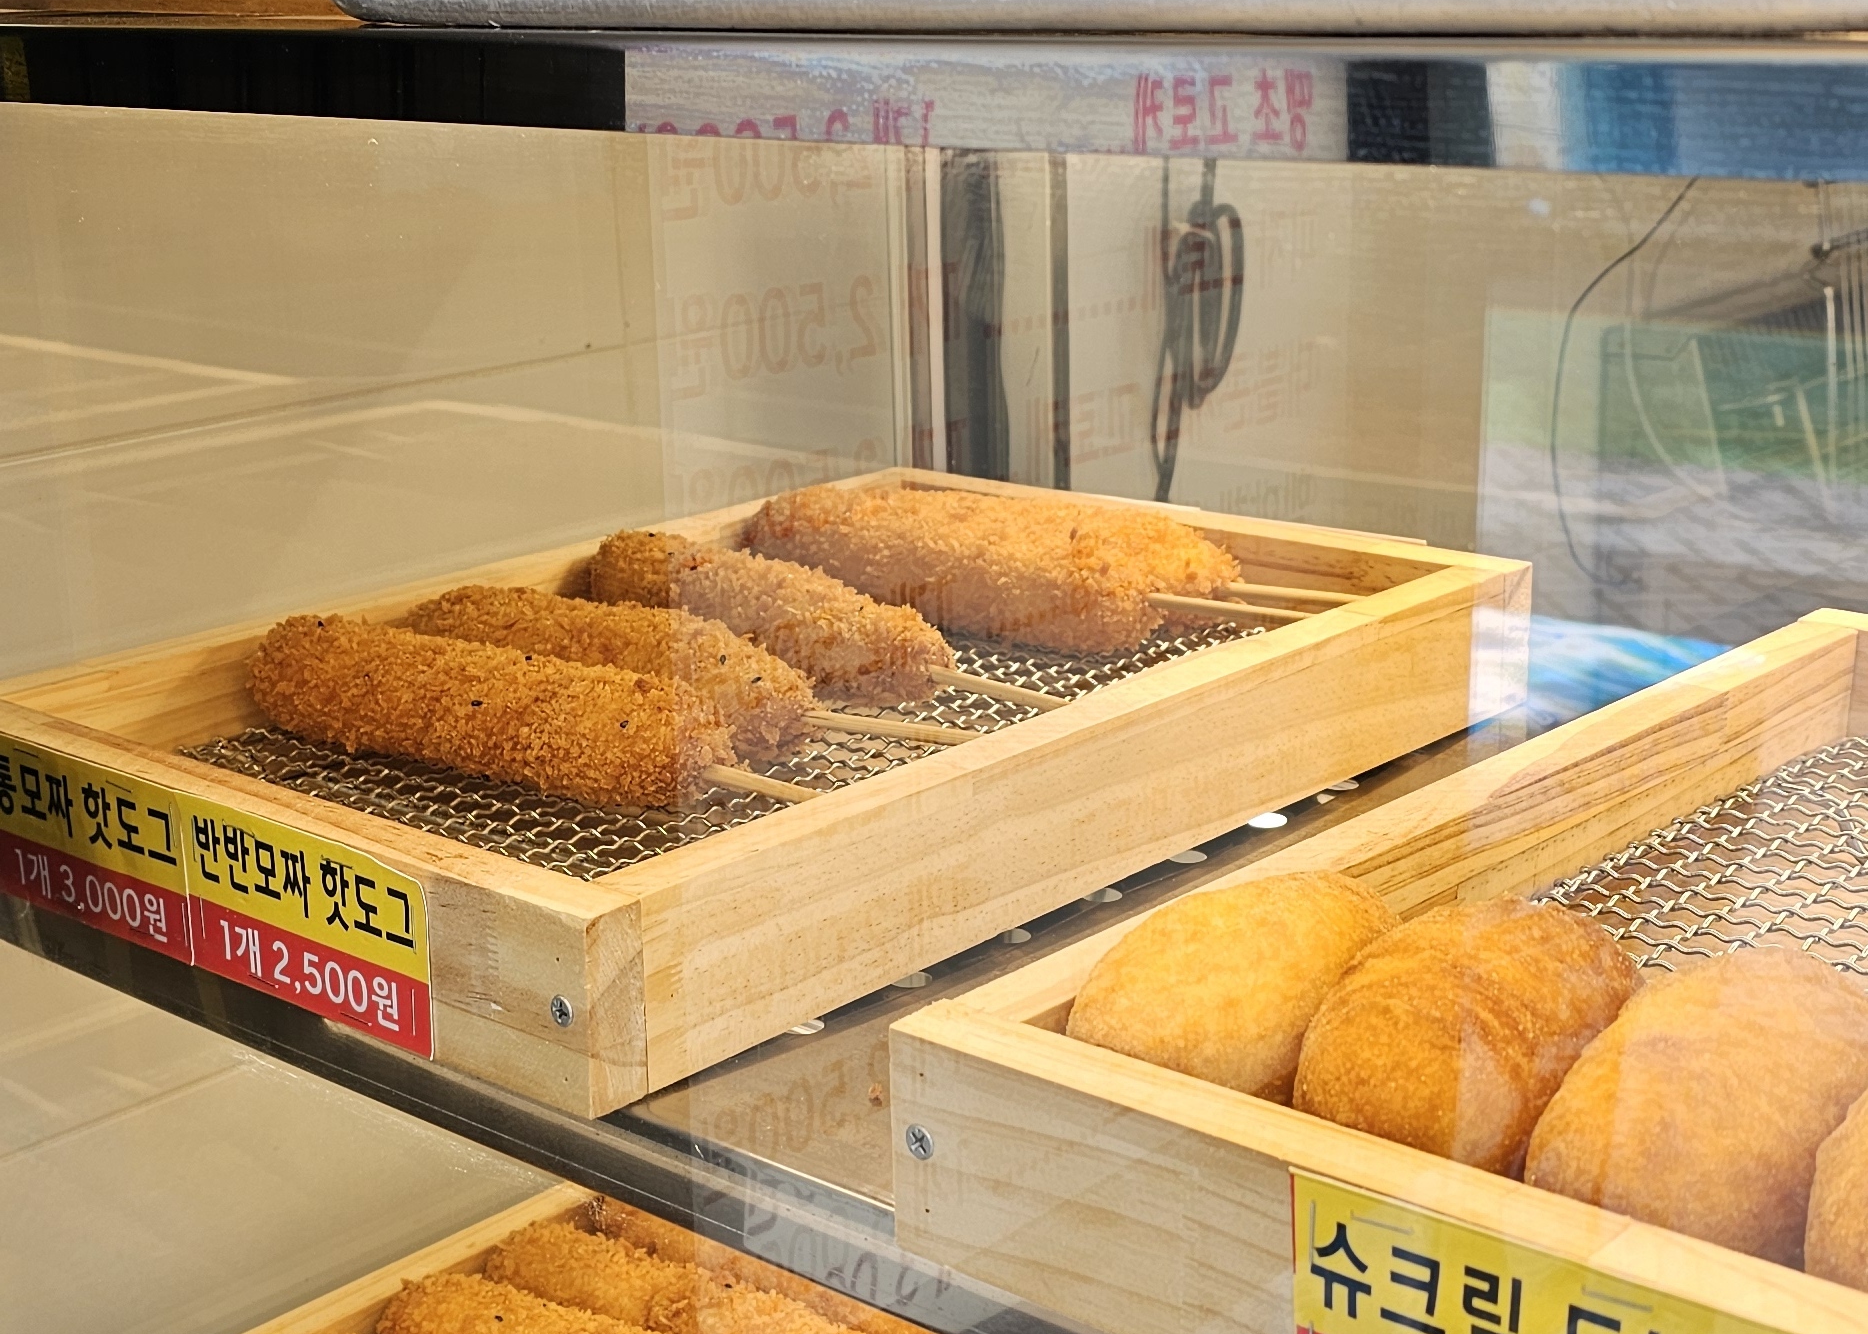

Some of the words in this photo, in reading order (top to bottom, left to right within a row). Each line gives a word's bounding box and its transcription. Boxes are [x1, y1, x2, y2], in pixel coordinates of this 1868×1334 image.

[0, 755, 73, 838] 통모짜
[81, 782, 177, 866] 핫도그
[14, 848, 52, 898] 1개
[59, 864, 168, 943] 3,000원
[194, 814, 312, 919] 반반모짜
[320, 860, 415, 950] 핫도그
[219, 919, 262, 978] 1개
[272, 941, 400, 1031] 2,500원
